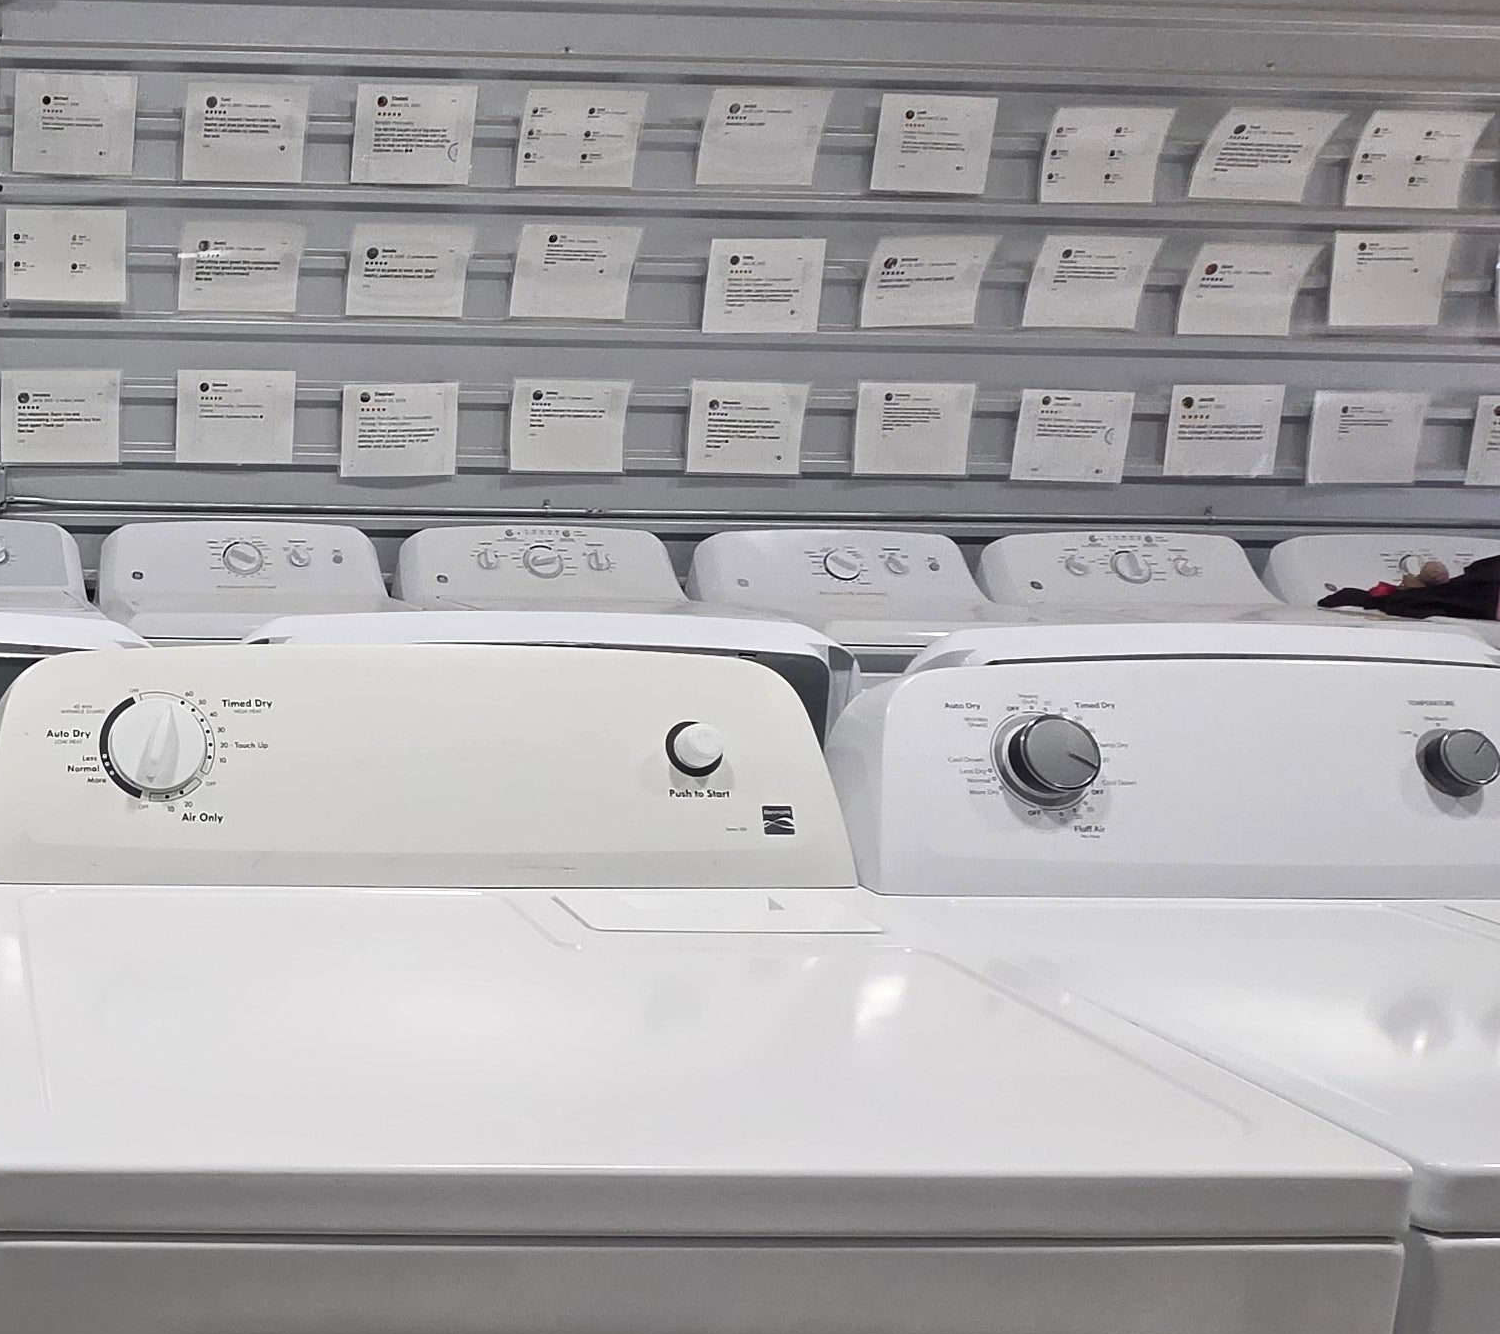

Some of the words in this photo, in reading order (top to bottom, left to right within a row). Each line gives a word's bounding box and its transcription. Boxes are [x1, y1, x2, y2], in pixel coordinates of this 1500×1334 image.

[222, 699, 252, 708] Timed
[255, 699, 272, 709] Dry
[46, 729, 70, 738] Auto
[73, 729, 91, 739] Dry
[68, 765, 100, 773] Normal
[670, 789, 692, 797] Push
[695, 789, 704, 797] to
[707, 789, 730, 797] Start
[182, 813, 198, 822] Air
[200, 813, 224, 823] Only
[1074, 825, 1092, 833] Fluff
[1094, 825, 1105, 833] Air
